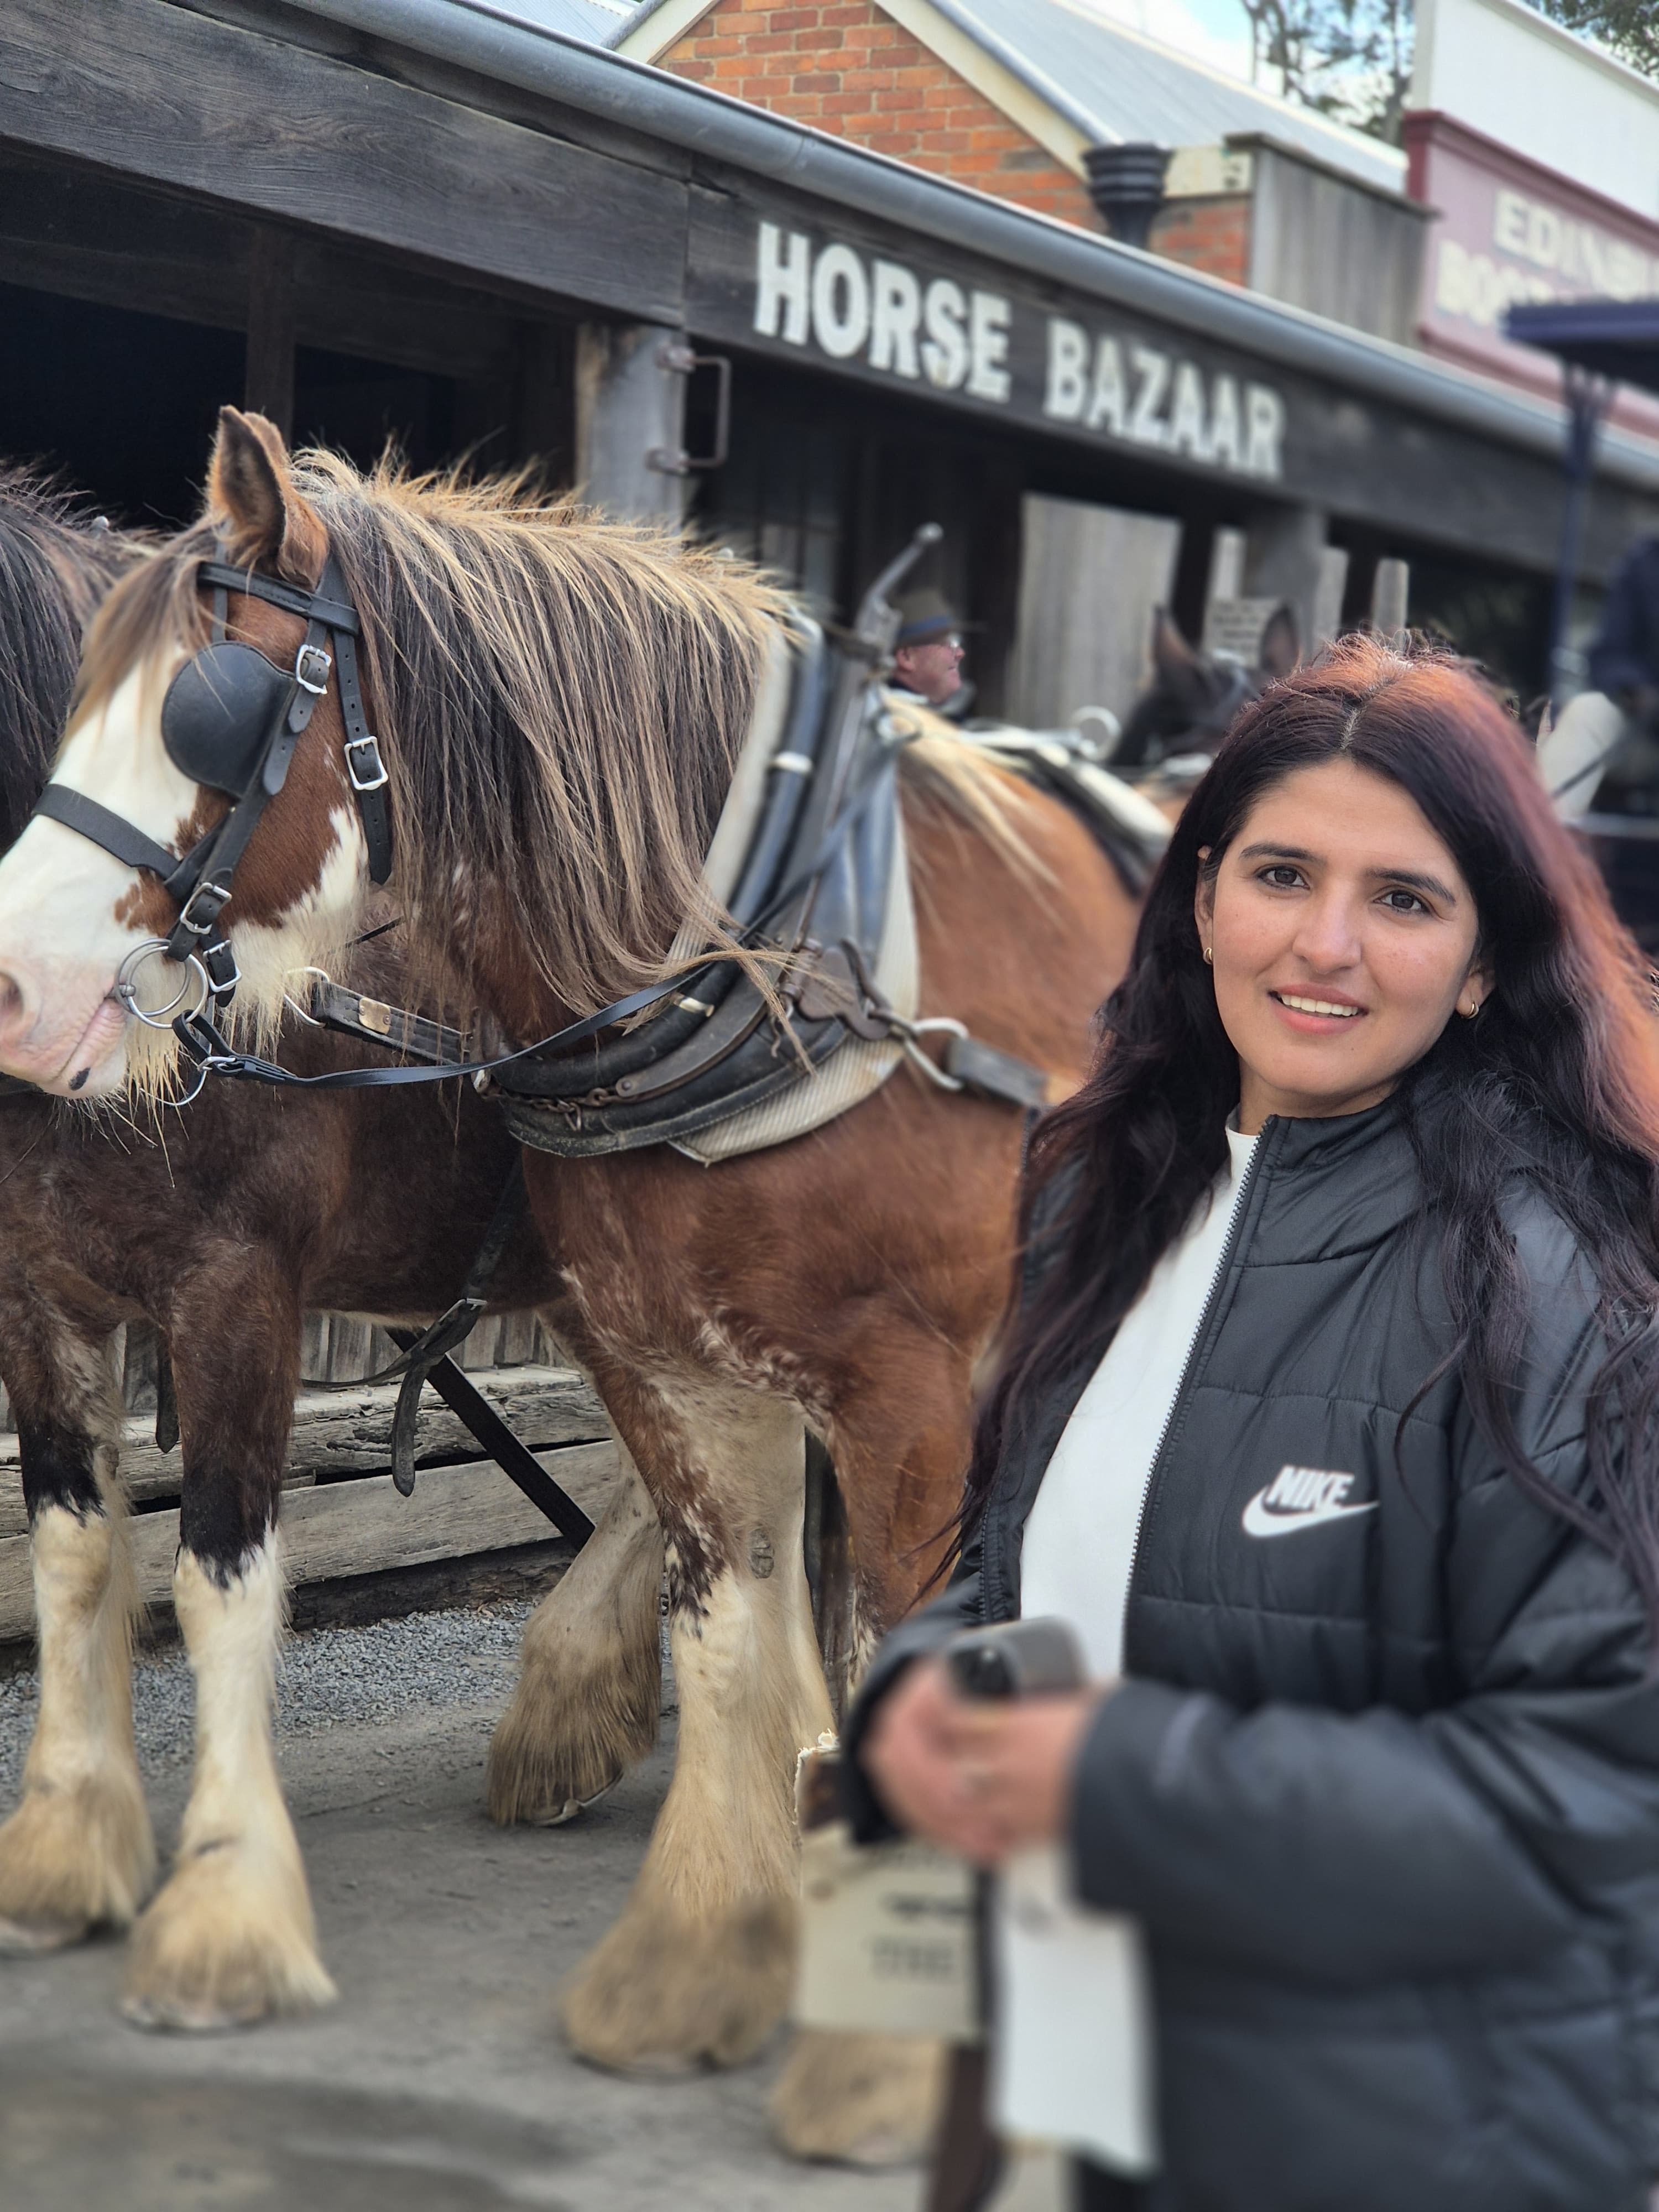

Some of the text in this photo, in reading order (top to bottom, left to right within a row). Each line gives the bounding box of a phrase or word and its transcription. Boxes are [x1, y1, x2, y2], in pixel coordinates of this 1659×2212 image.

[754, 221, 1285, 479] HORSE BAZAAR
[1266, 1465, 1355, 1512] NIKE
